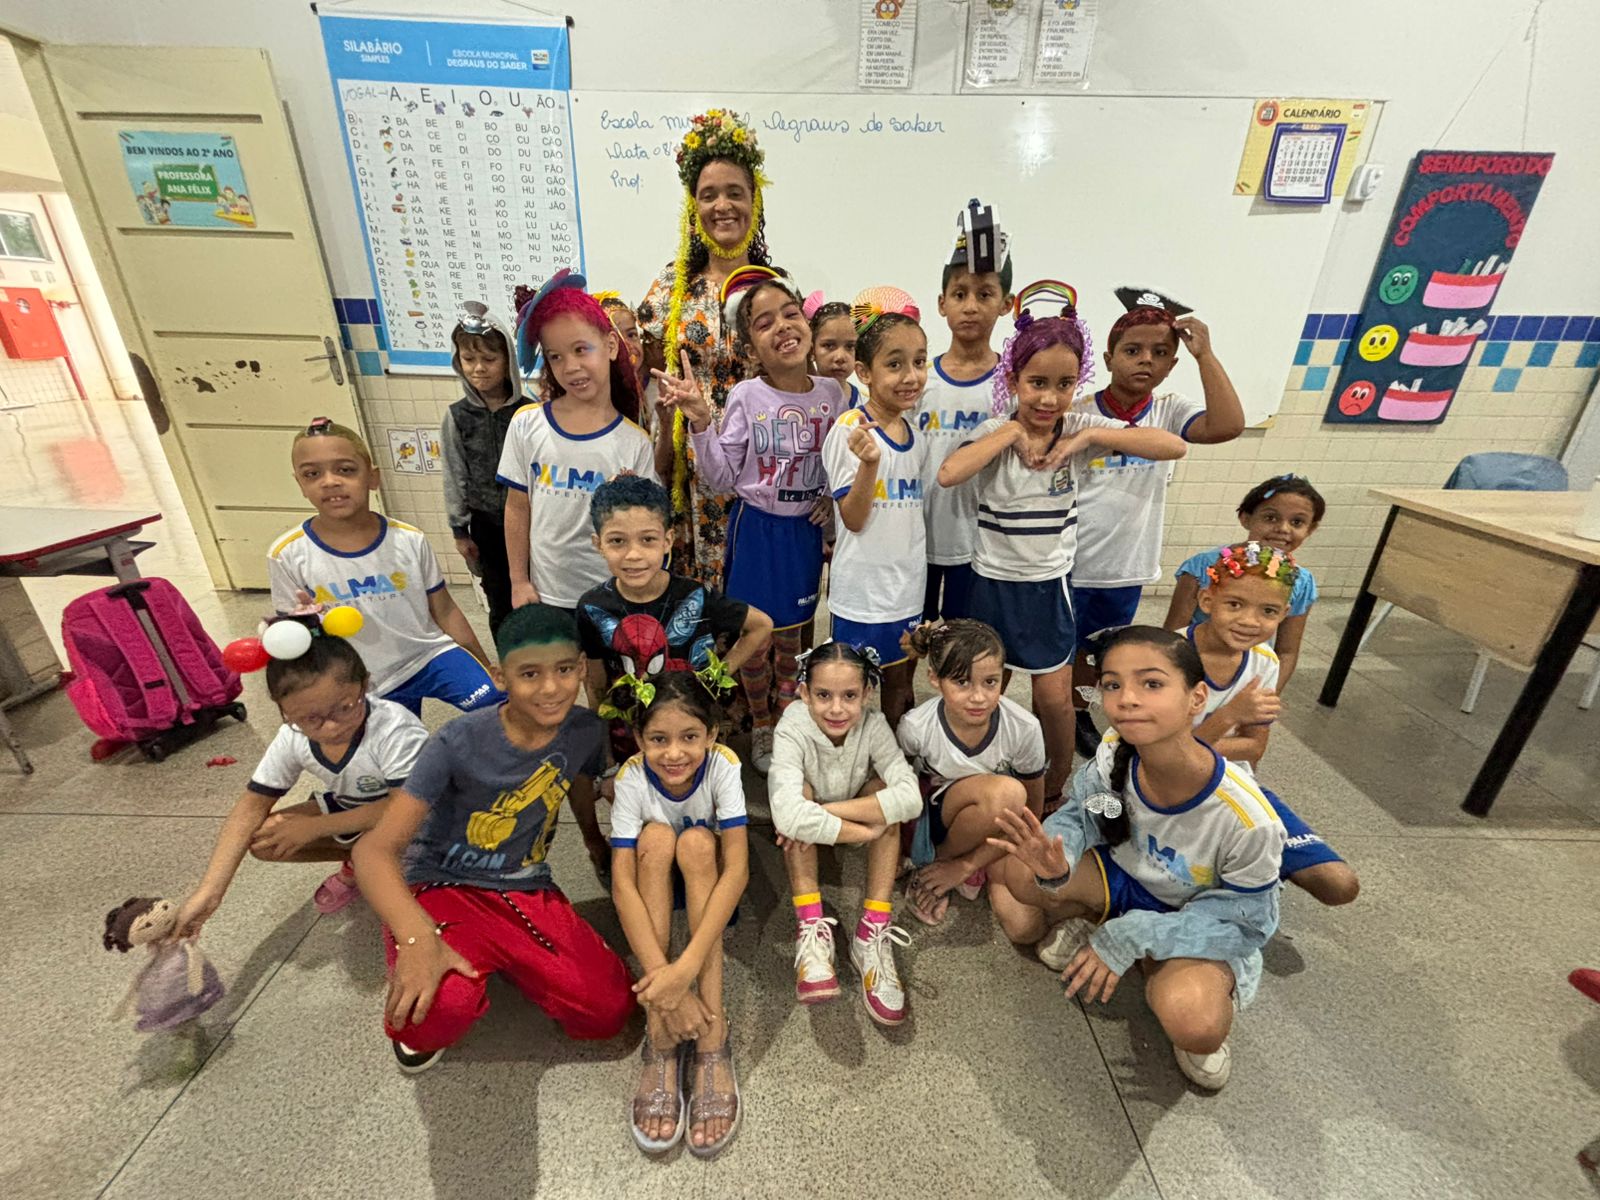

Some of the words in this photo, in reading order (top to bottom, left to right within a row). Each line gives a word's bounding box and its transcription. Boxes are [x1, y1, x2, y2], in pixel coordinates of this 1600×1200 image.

[343, 38, 402, 56] SILABÁRIO
[360, 54, 390, 64] SIMPLES
[452, 49, 480, 58] ESCOLA
[481, 50, 518, 60] MUNICIPAL
[447, 58, 483, 68] DEGRAUS
[485, 60, 499, 69] DO
[500, 61, 528, 70] SABER
[390, 86, 401, 100] A
[420, 88, 432, 103] E
[451, 89, 455, 104] I
[479, 90, 492, 106] O
[509, 91, 520, 107] U
[536, 94, 555, 108] ÃO
[1283, 106, 1342, 119] CALENDÁRIO
[396, 117, 409, 126] BA
[425, 118, 438, 127] BE
[456, 120, 464, 128] BI
[485, 122, 497, 131] BO
[515, 123, 527, 132] BU
[600, 110, 654, 130] Escola
[398, 130, 411, 138] CA
[428, 132, 440, 140] CE
[458, 133, 466, 141] CI
[486, 134, 500, 143] CO
[517, 136, 529, 144] CU
[126, 146, 146, 155] BEM
[148, 146, 184, 156] VINDOS
[186, 148, 200, 157] AO
[213, 149, 234, 158] ANO
[401, 143, 414, 151] DA
[430, 144, 442, 153] DE
[460, 146, 468, 154] DI
[488, 148, 501, 156] DO
[518, 149, 530, 157] DU
[403, 158, 415, 166] FA
[432, 159, 443, 167] FE
[490, 162, 502, 171] FO
[520, 163, 531, 172] FU
[158, 170, 213, 181] PROFESSORA
[405, 170, 419, 178] GA
[434, 172, 447, 180] GE
[492, 174, 505, 182] GO
[521, 175, 534, 183] GU
[167, 184, 187, 194] ANA
[188, 183, 211, 194] FÉLIX
[436, 182, 448, 190] HE
[492, 185, 505, 193] HO
[439, 196, 448, 204] JE
[1393, 182, 1528, 248] COMPORTAMENTO
[528, 232, 540, 240] MU
[919, 410, 988, 430] PALMA
[531, 462, 605, 492] PALMA
